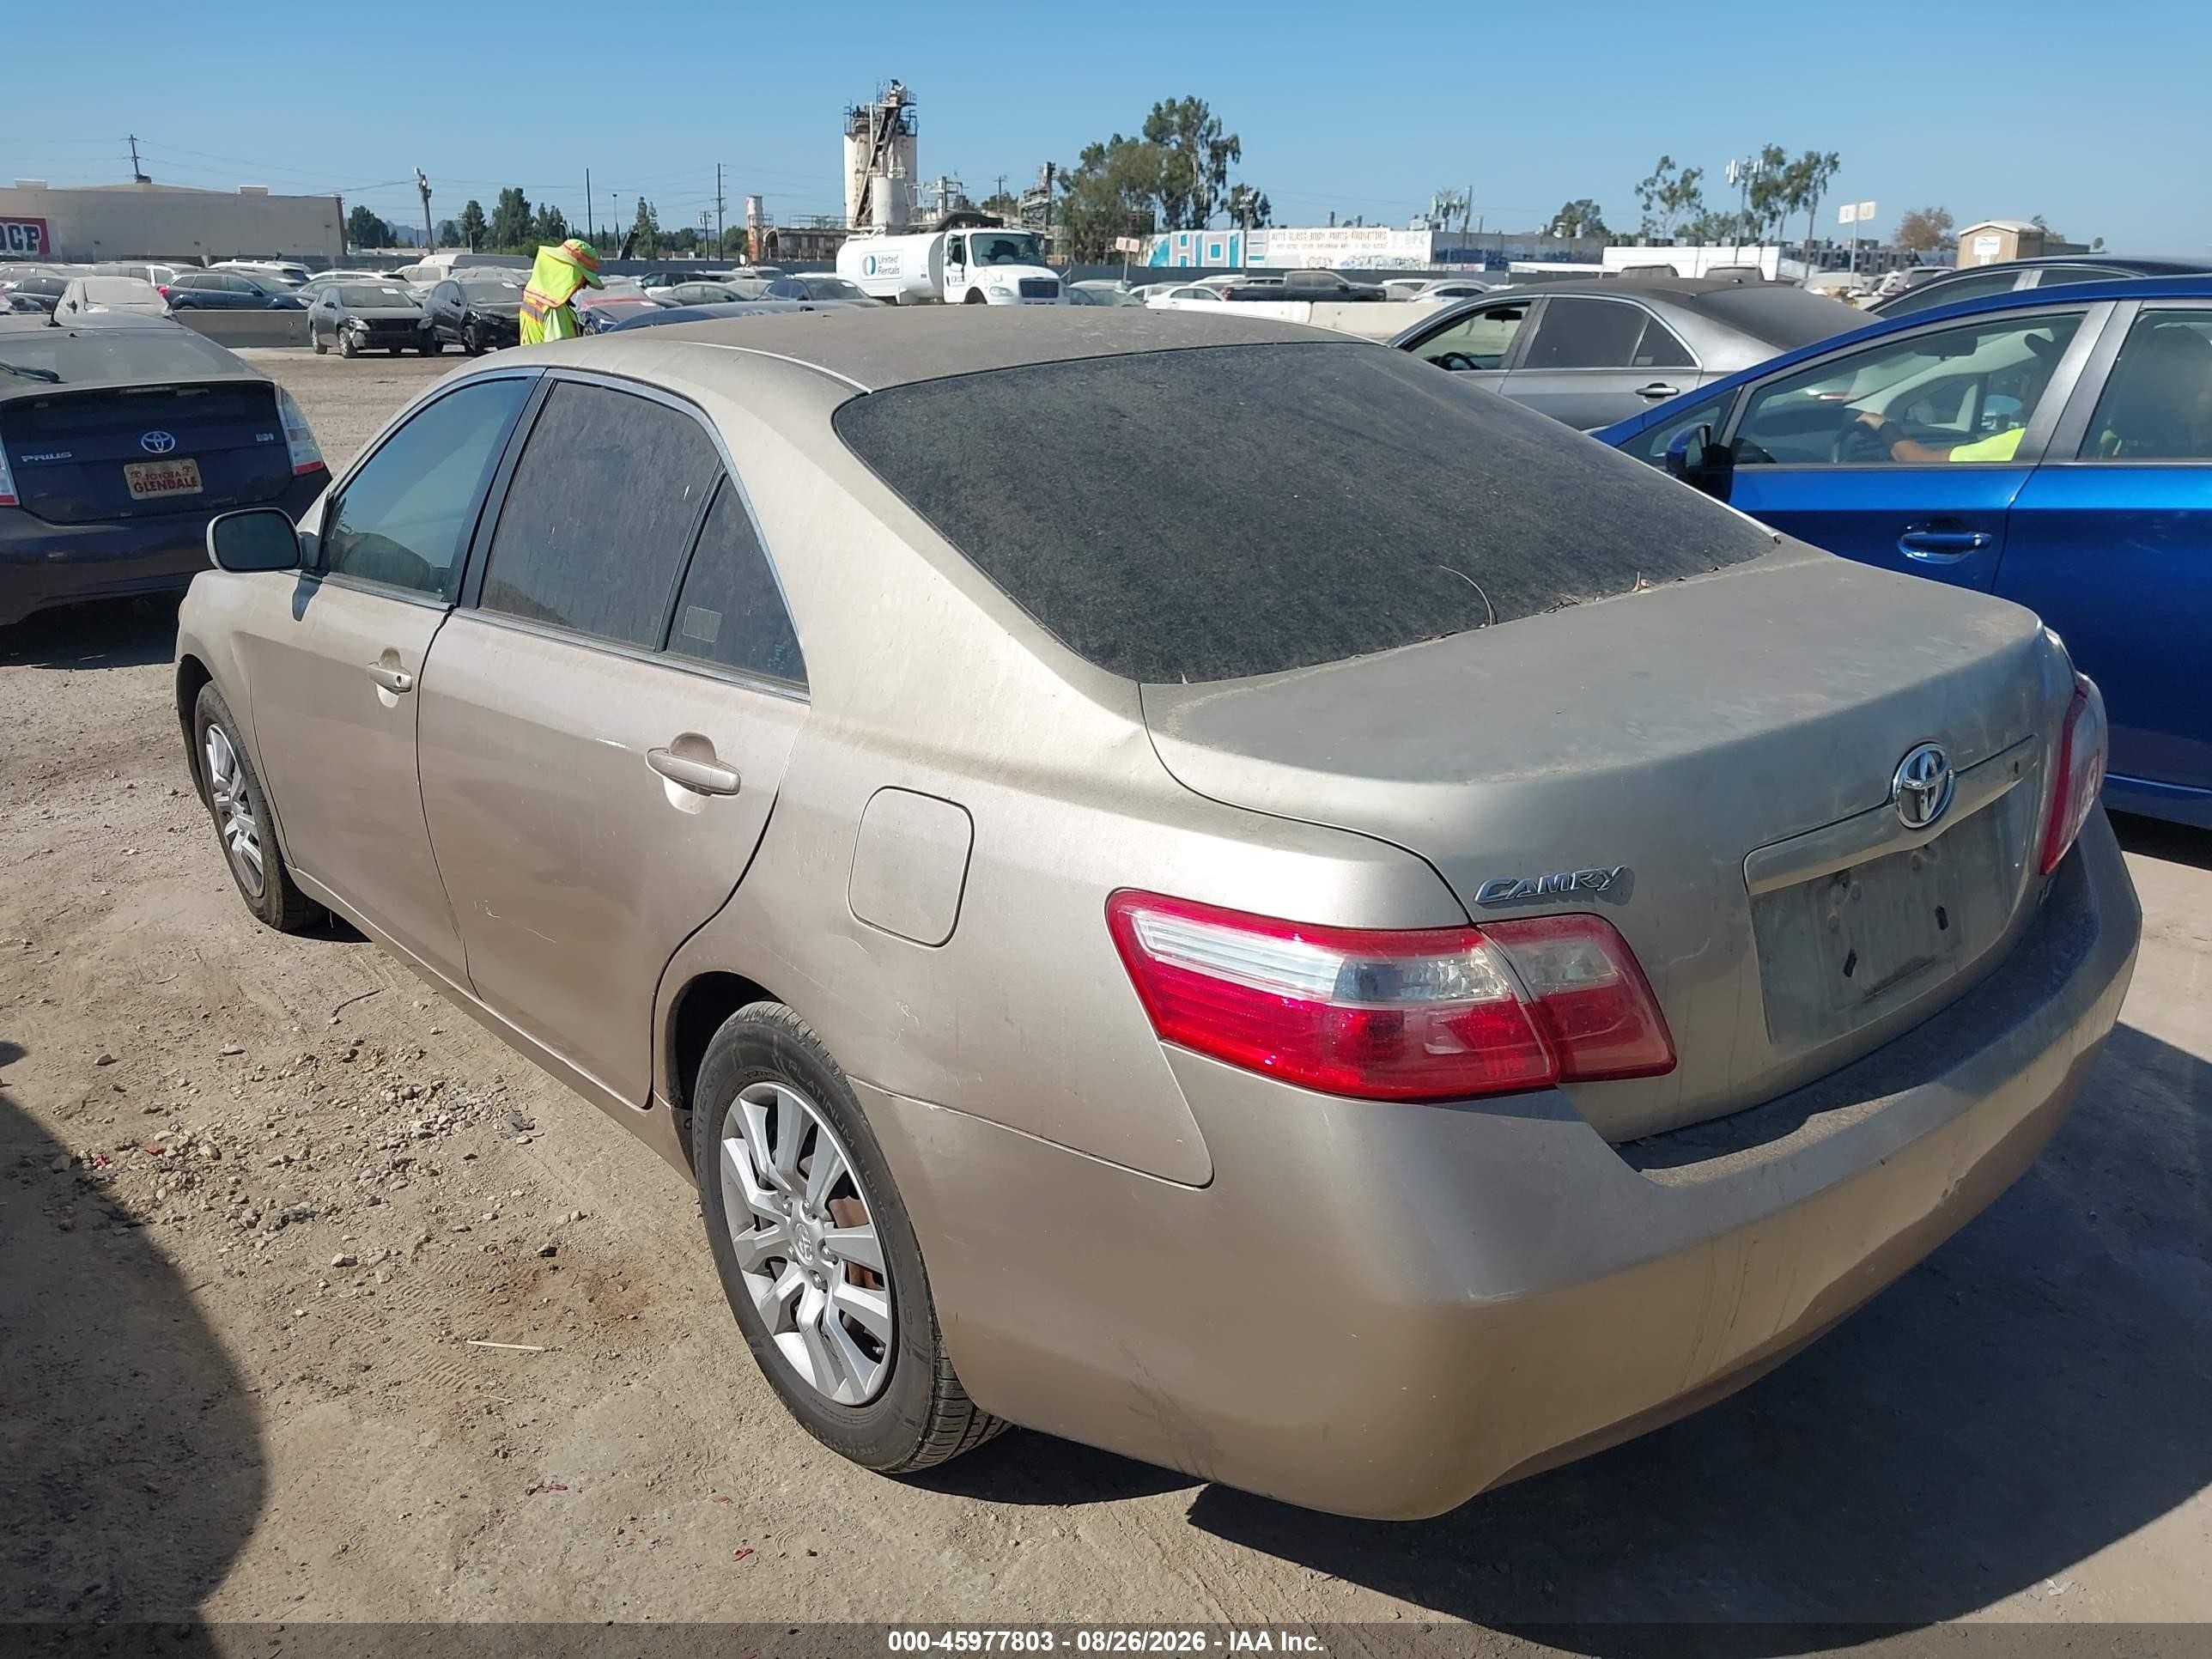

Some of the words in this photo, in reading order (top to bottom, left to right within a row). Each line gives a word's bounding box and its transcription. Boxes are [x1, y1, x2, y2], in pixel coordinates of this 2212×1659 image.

[878, 254, 899, 264] United
[878, 265, 900, 276] Rentals
[145, 471, 182, 482] TOYOTA
[134, 476, 198, 494] GLENDALE
[1474, 865, 1627, 903] CAMRY
